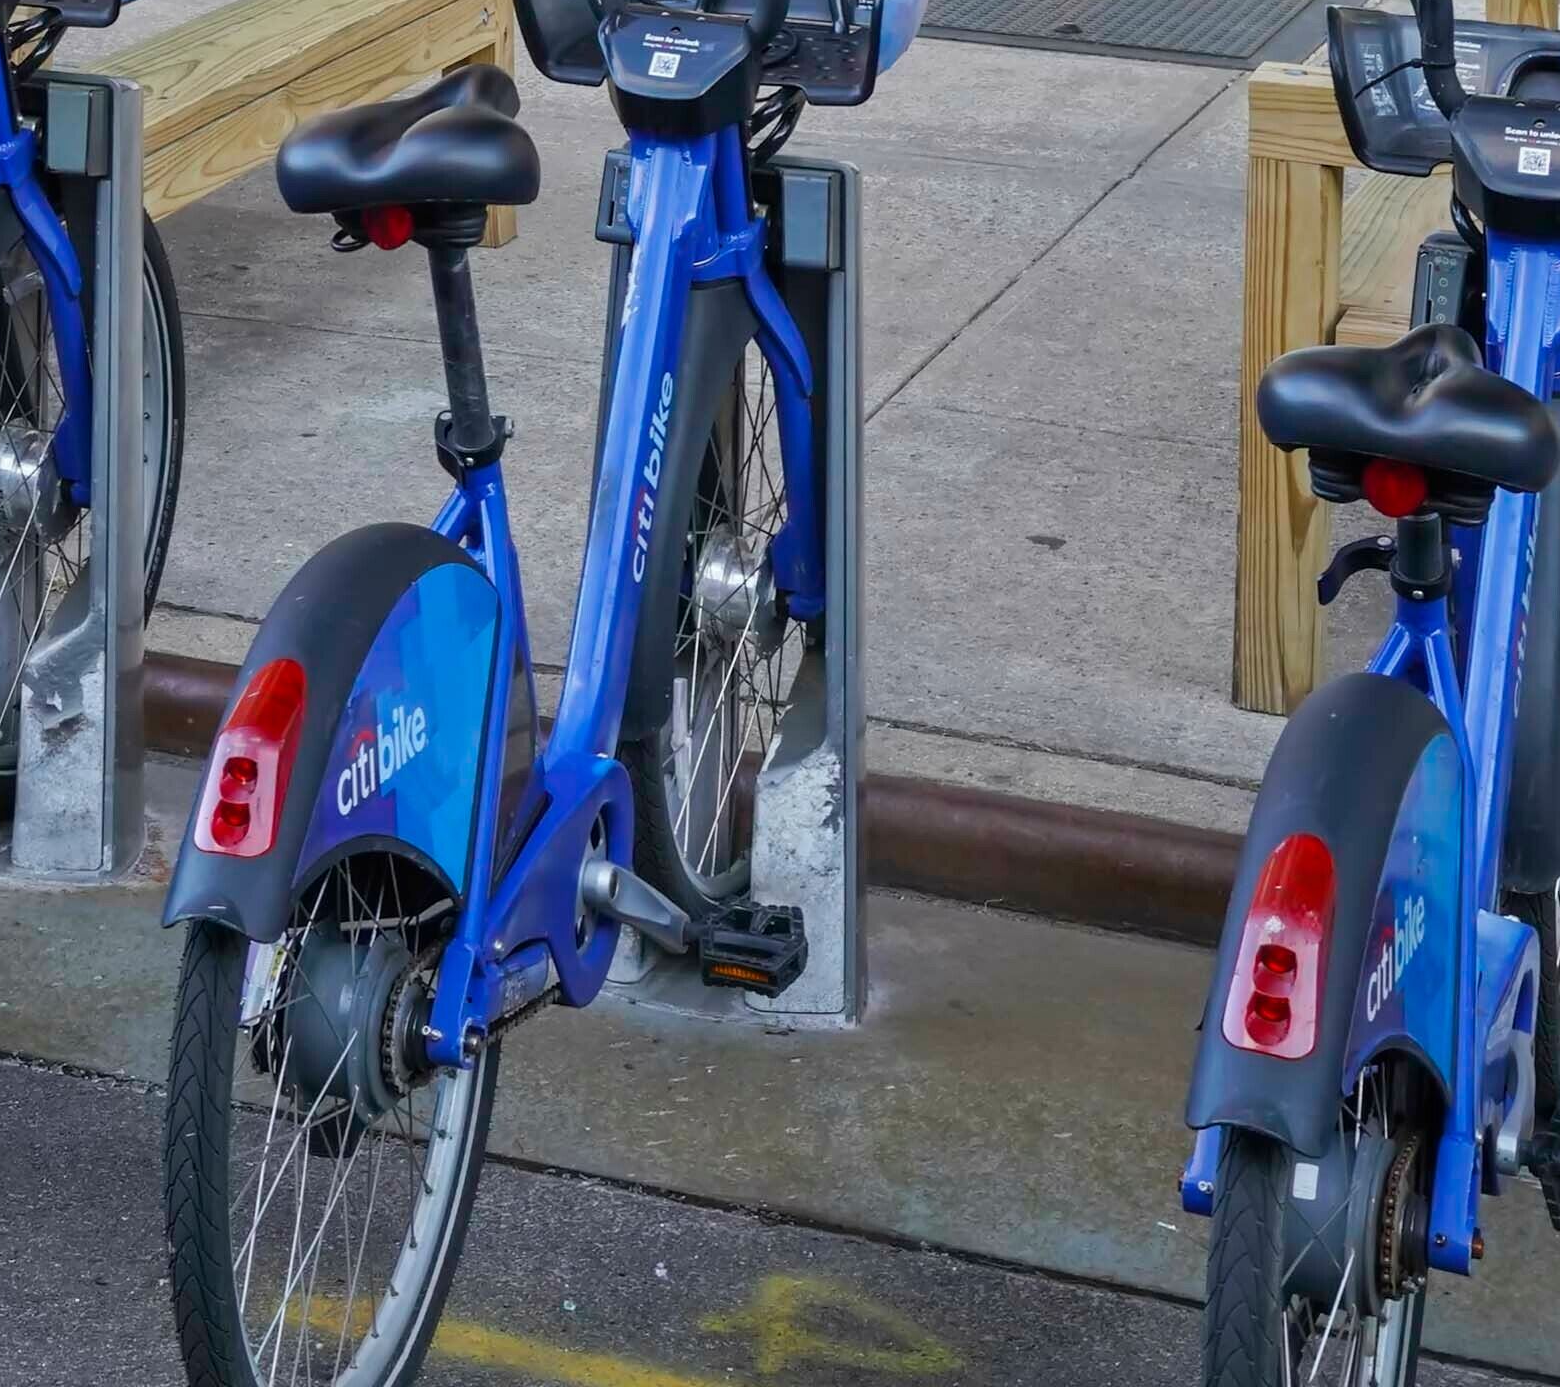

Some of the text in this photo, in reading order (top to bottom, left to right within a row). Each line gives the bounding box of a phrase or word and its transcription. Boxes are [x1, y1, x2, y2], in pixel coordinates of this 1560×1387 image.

[1505, 127, 1527, 136] Scan
[1529, 128, 1539, 137] to
[631, 369, 677, 586] citi bike
[336, 704, 427, 818] citi bike
[1365, 893, 1426, 1024] citi bike
